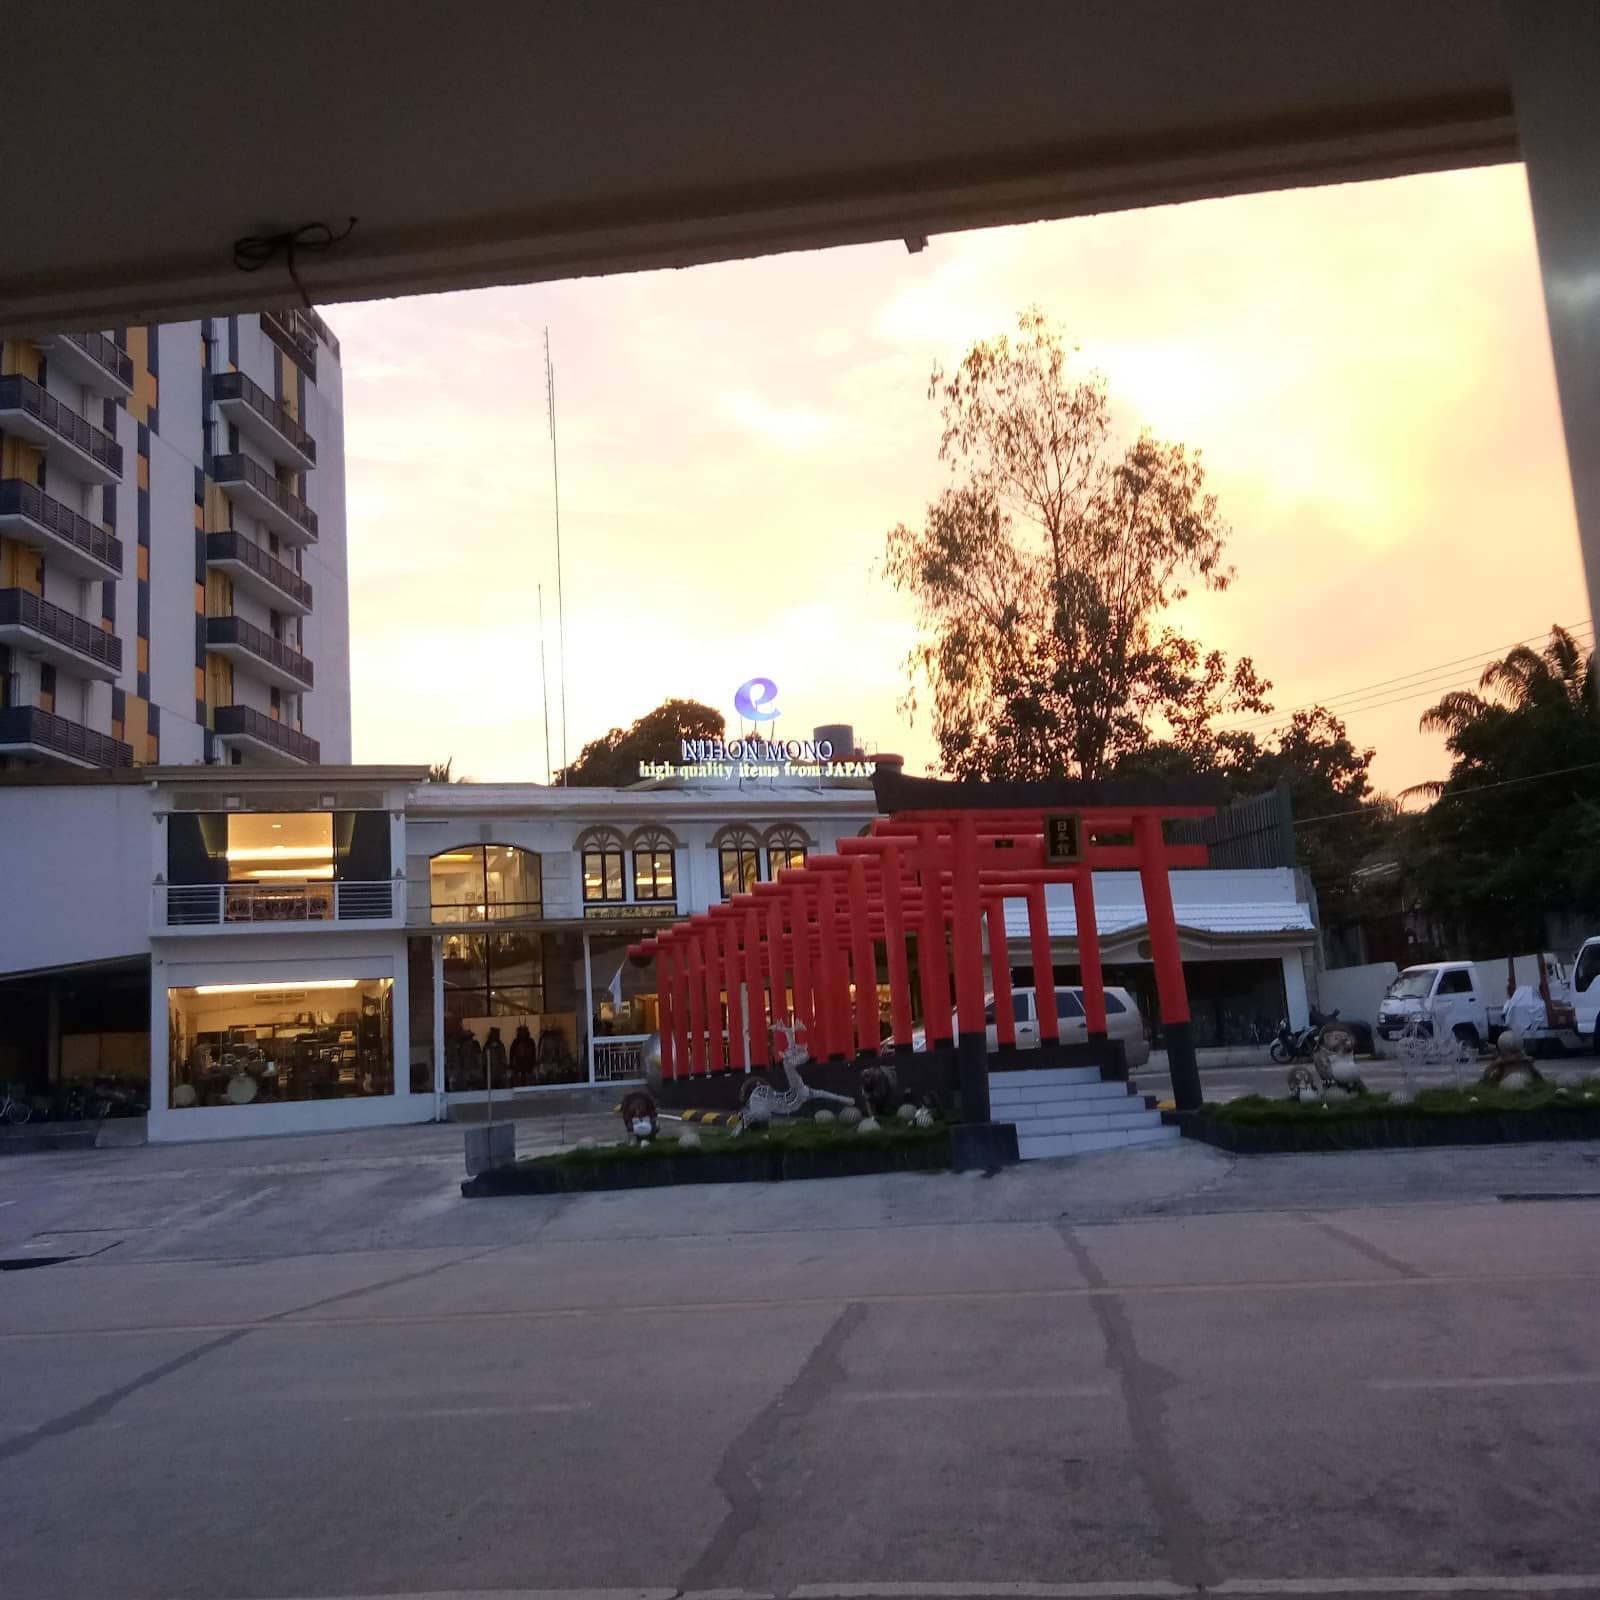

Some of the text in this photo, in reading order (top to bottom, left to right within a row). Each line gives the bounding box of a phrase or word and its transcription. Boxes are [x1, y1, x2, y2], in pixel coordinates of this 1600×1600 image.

[735, 677, 781, 721] e
[682, 739, 833, 761] NIHON MONO
[639, 761, 876, 780] high quality items from JAPAN
